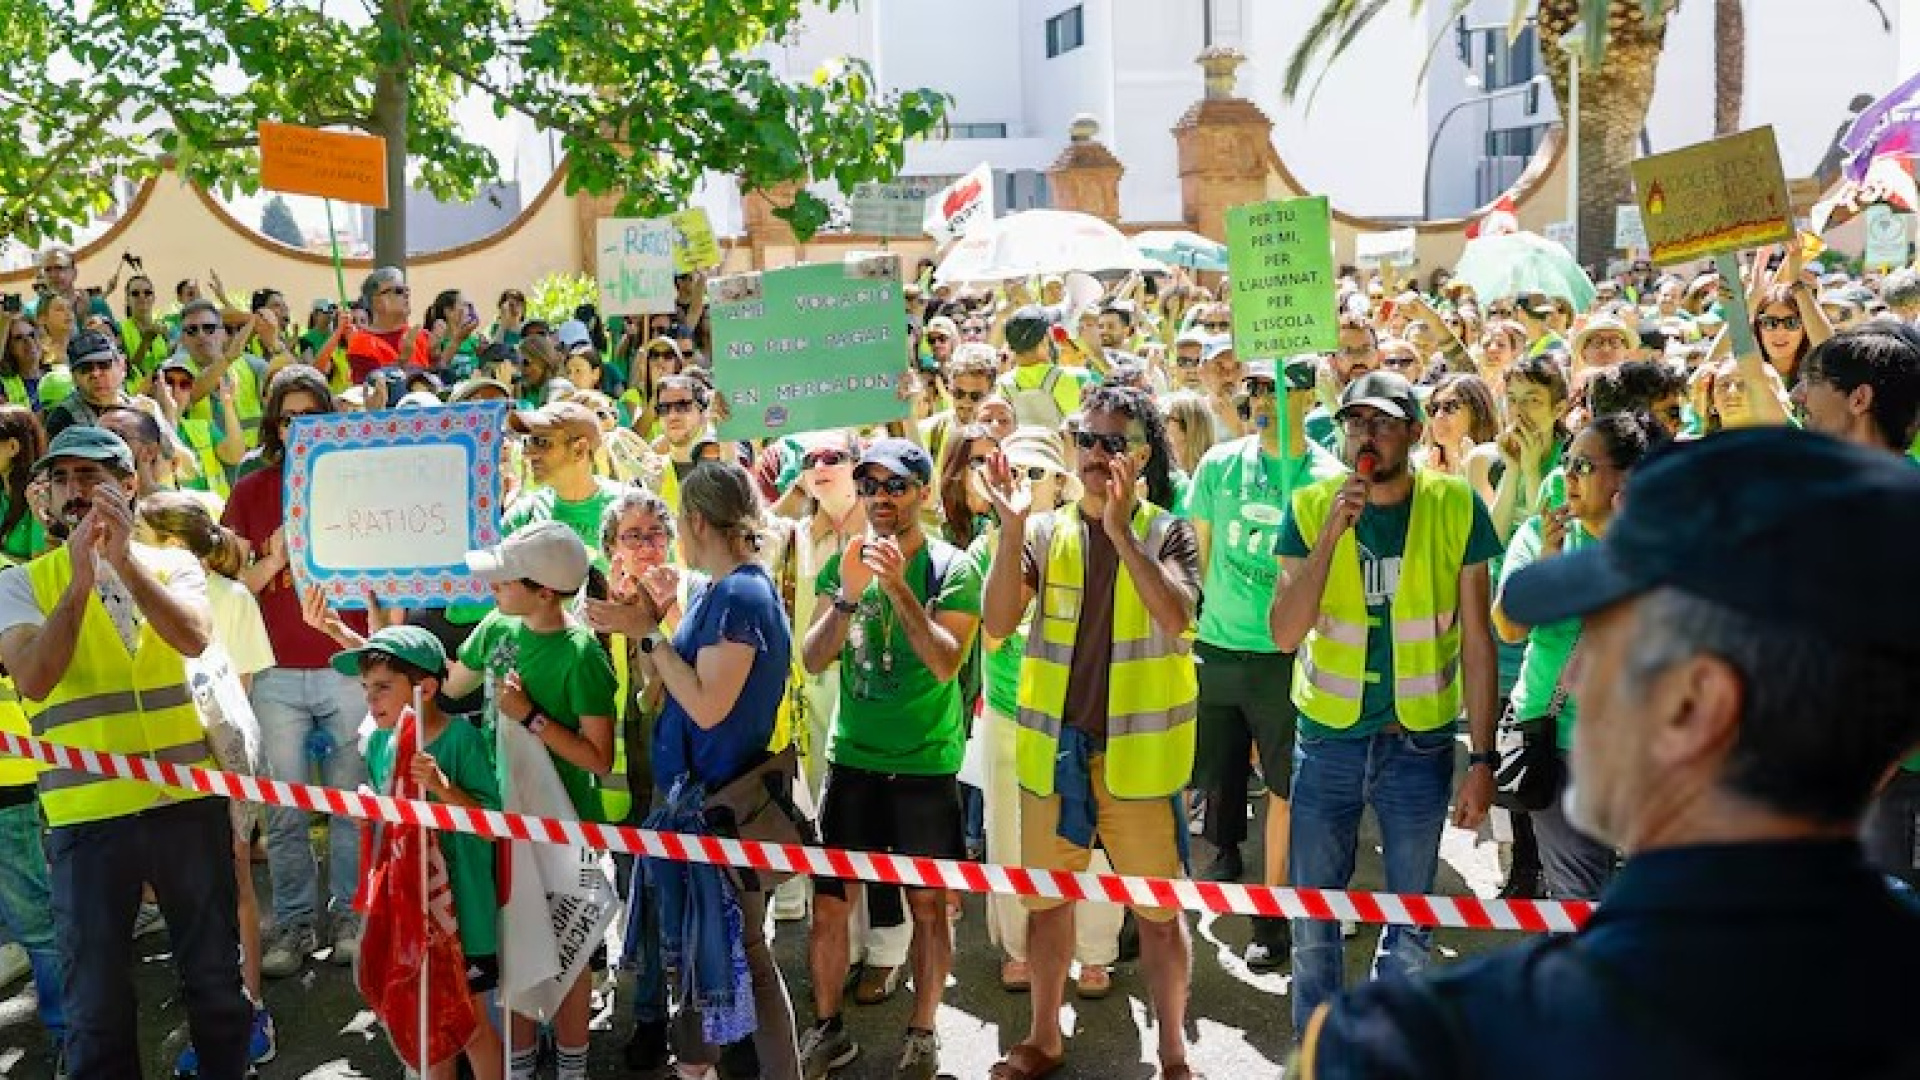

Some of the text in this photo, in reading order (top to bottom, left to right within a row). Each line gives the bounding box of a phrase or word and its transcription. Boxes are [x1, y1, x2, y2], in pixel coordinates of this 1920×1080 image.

[1249, 213, 1272, 227] PER
[1251, 233, 1273, 248] PER
[1264, 253, 1291, 267] PER
[1266, 294, 1293, 308] PER
[727, 341, 756, 359] NO
[732, 386, 761, 405] EN
